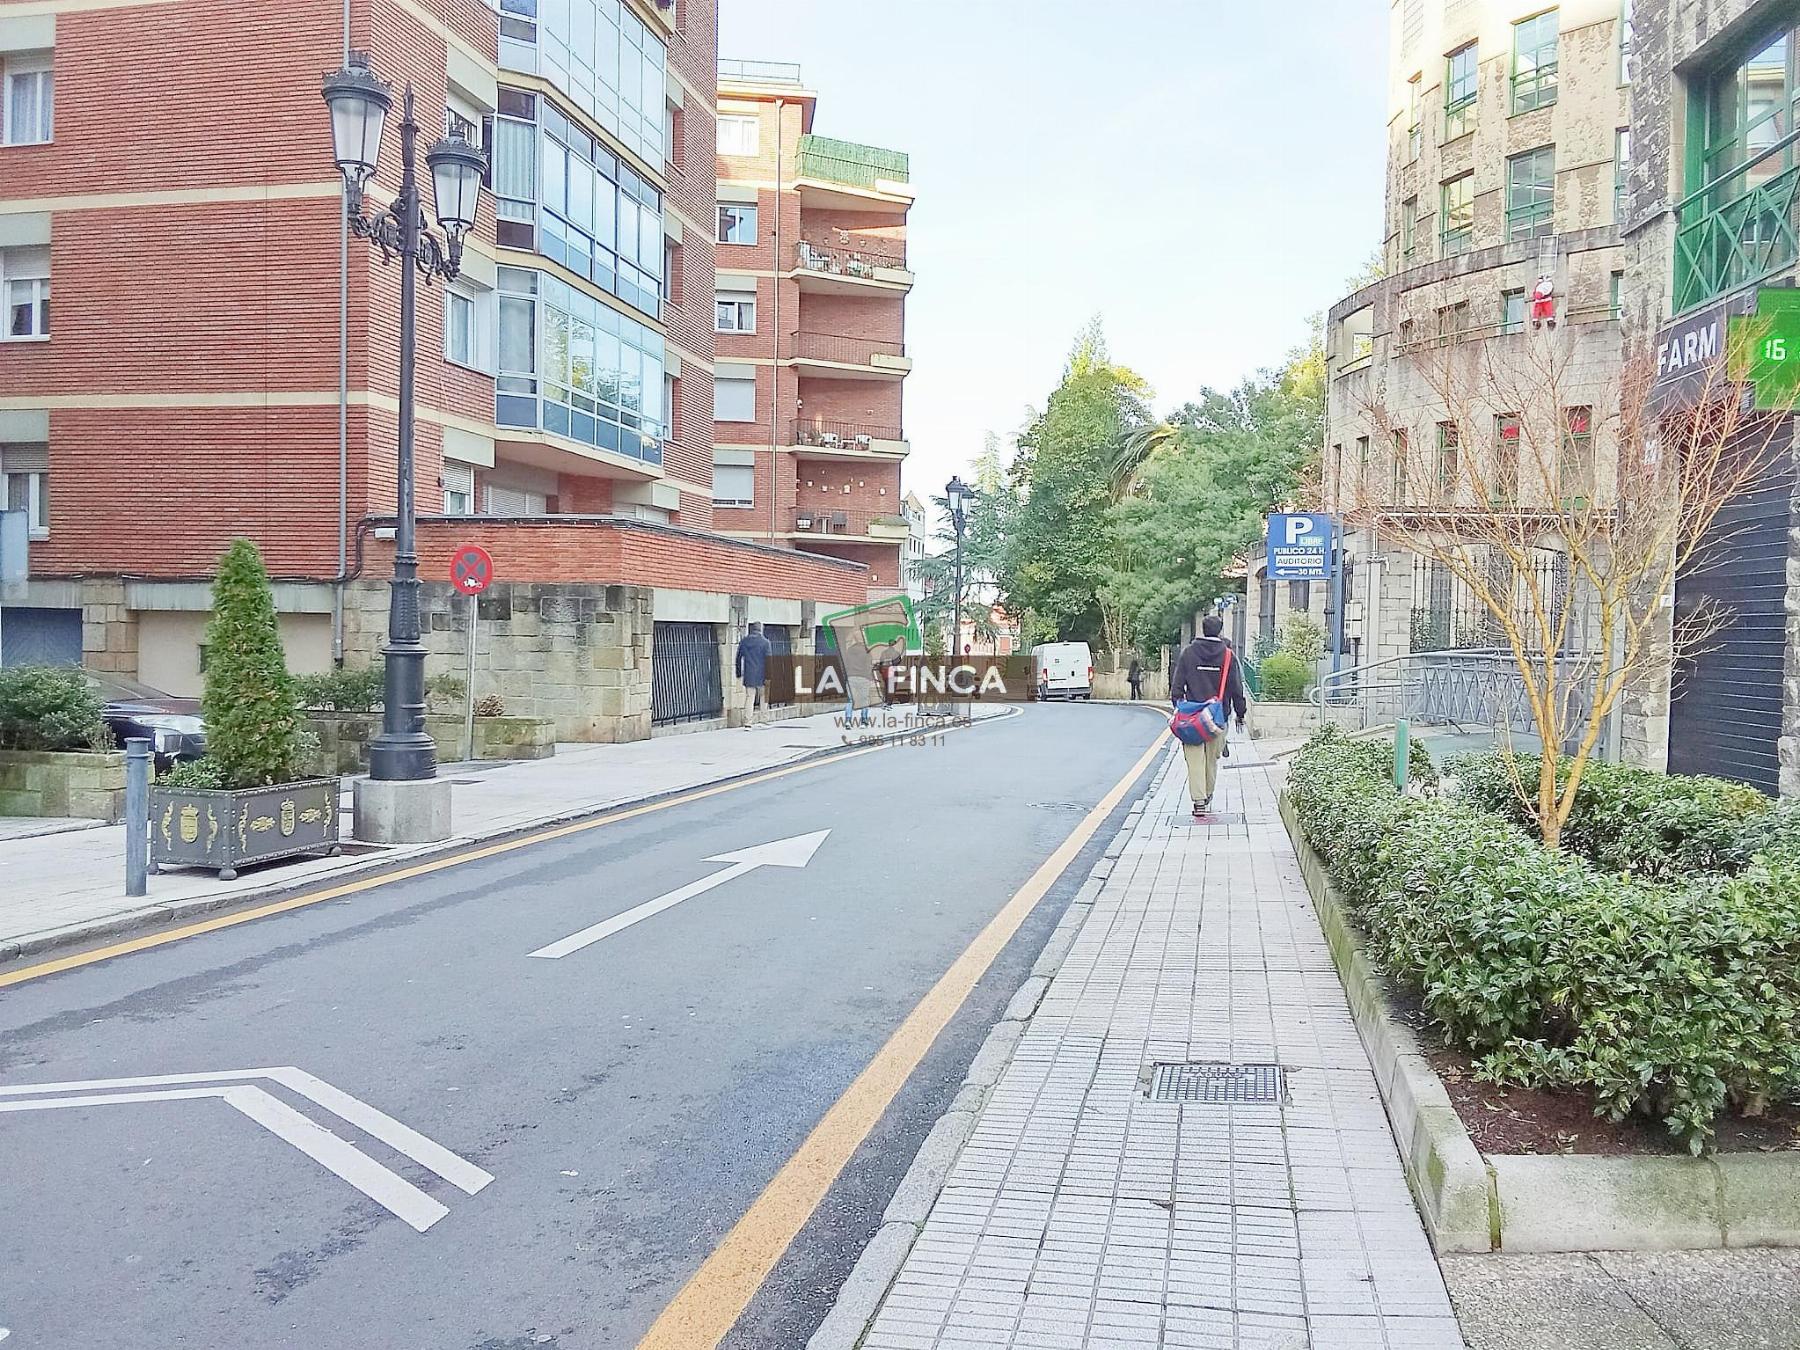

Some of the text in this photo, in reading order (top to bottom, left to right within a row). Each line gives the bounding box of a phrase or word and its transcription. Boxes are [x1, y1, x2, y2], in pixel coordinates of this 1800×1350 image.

[1765, 338, 1786, 361] 16
[1286, 517, 1313, 544] P
[1306, 547, 1317, 555] 24
